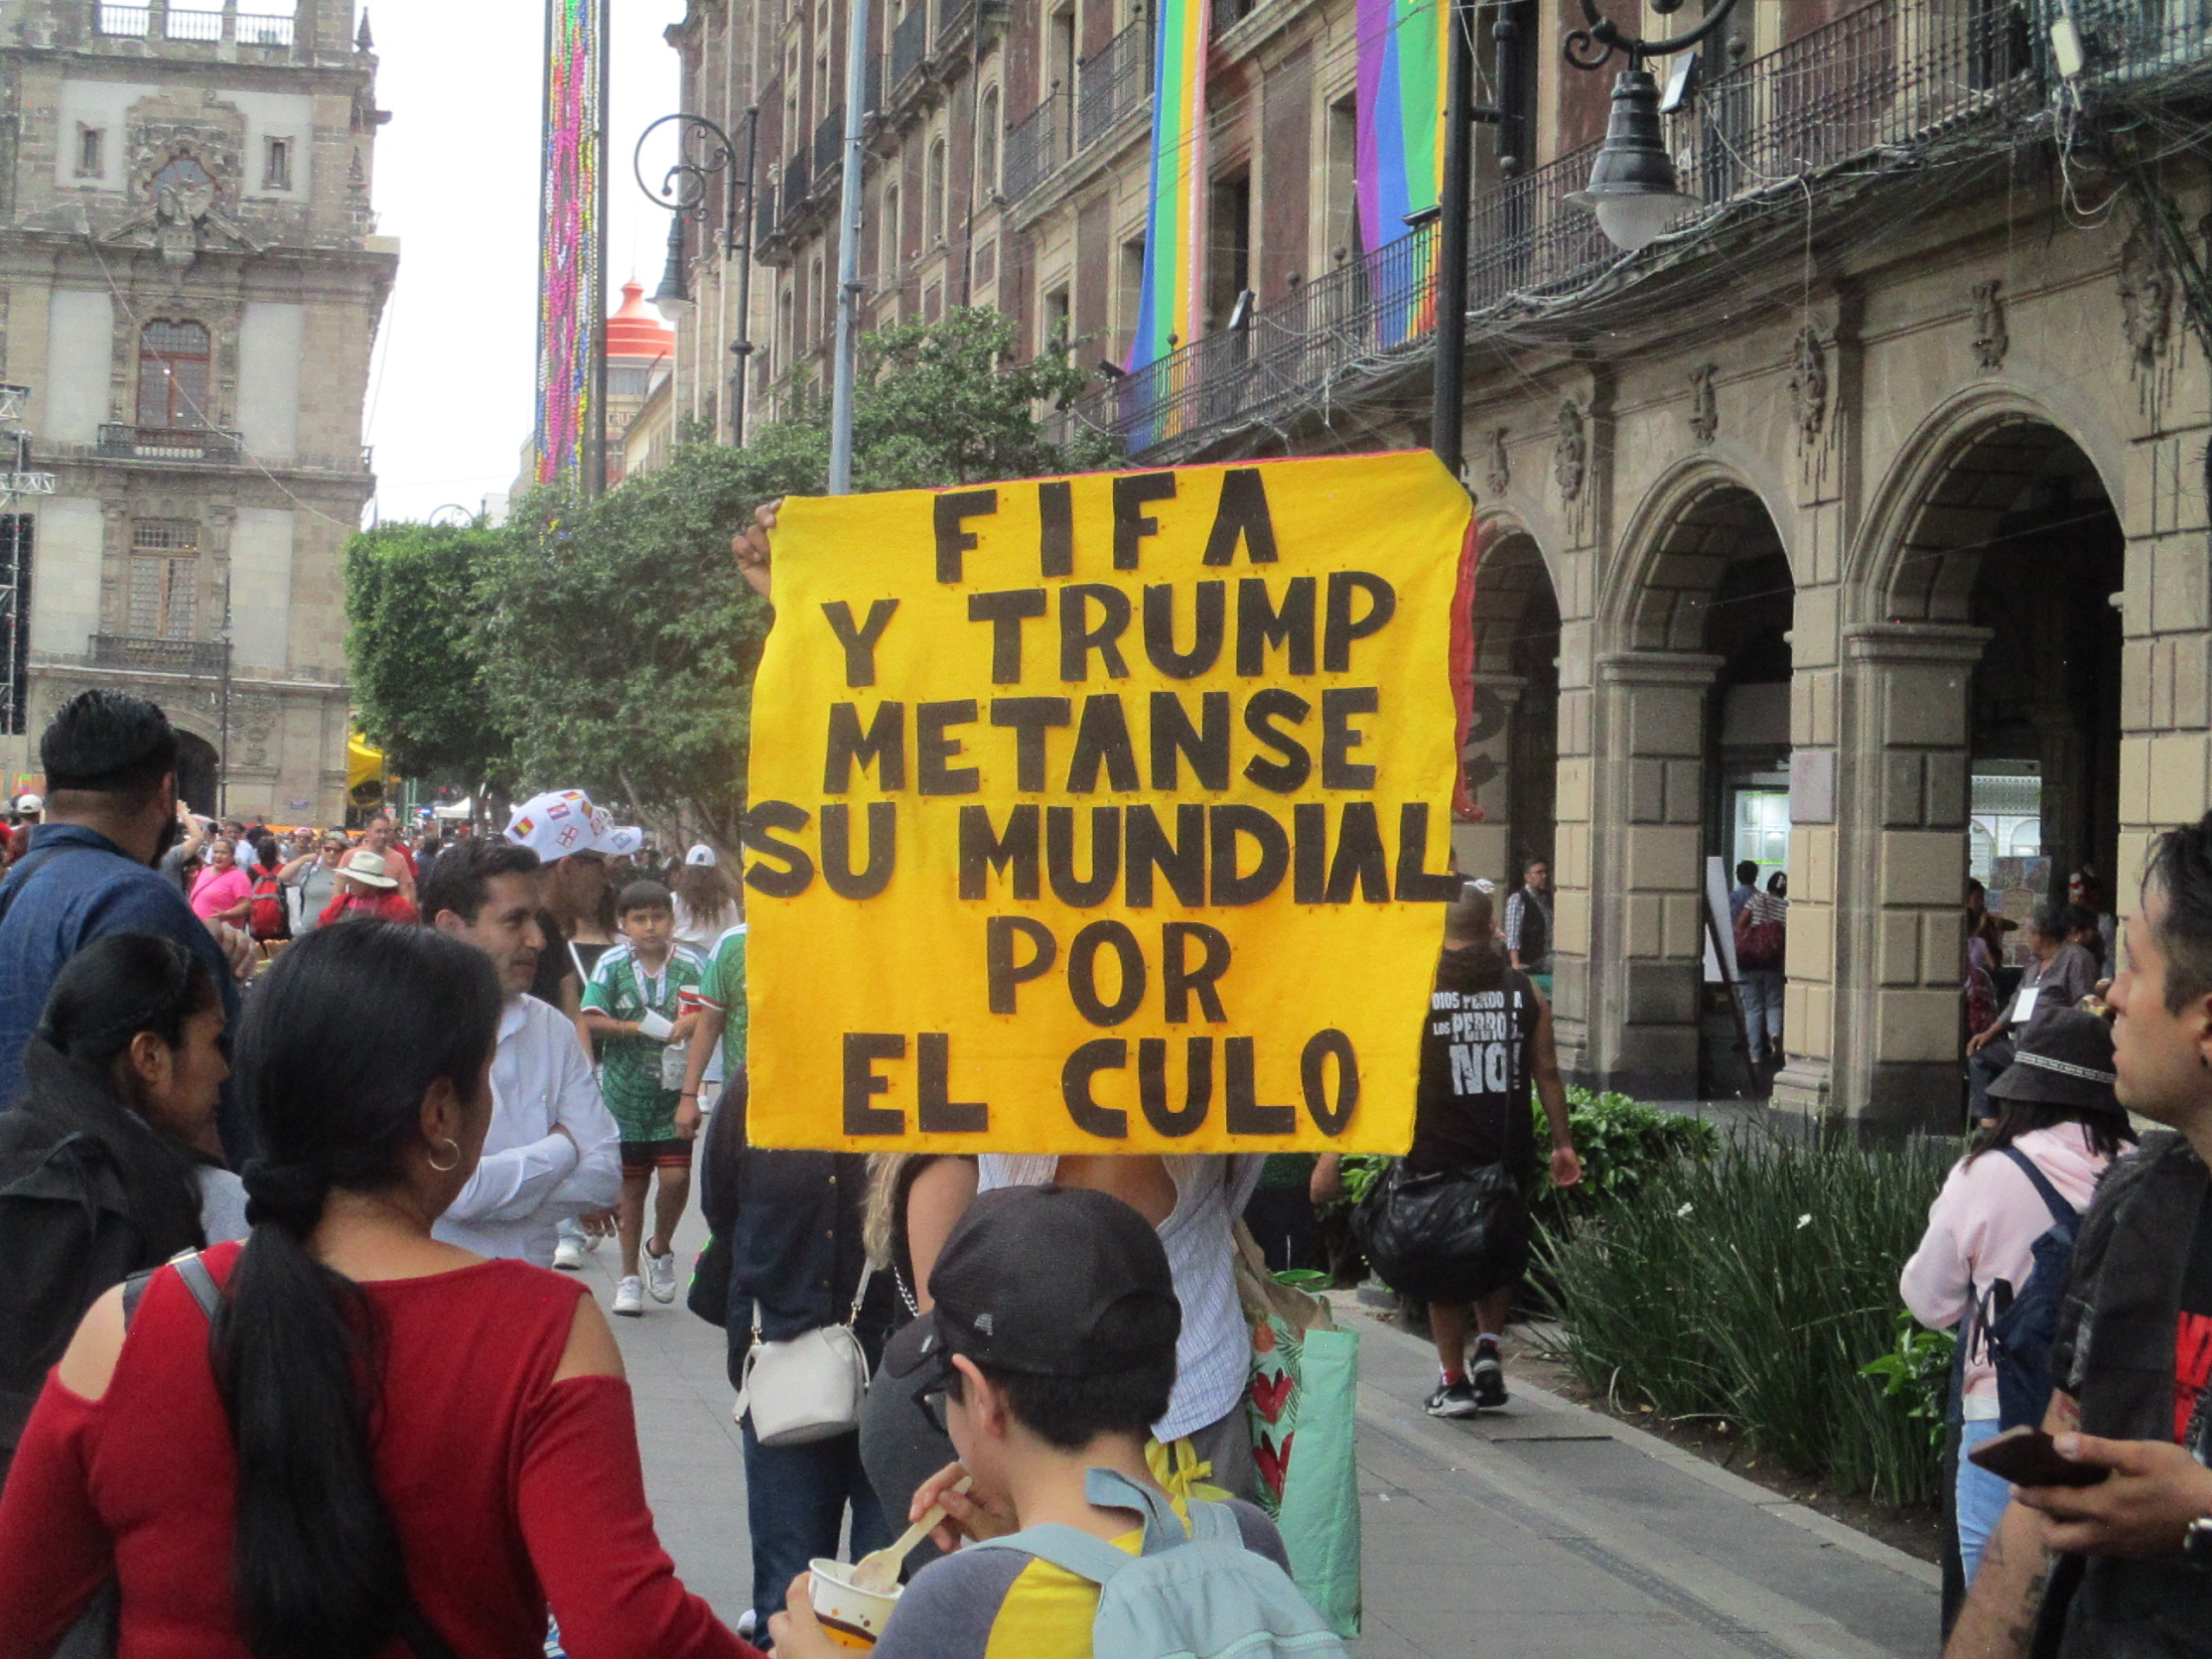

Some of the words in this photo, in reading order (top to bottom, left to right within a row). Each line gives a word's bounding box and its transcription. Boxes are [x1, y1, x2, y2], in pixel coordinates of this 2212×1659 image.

[933, 467, 1279, 584] FIFA
[822, 598, 899, 688] Y
[968, 570, 1396, 684] TRUMP
[823, 686, 1379, 796] METANSE
[742, 800, 897, 900] SU
[958, 801, 1462, 909] MUNDIAL
[987, 916, 1232, 1027] POR
[1432, 991, 1460, 1010] DIOS
[842, 1033, 988, 1136] EL
[1060, 1027, 1360, 1139] CULO
[1433, 1021, 1451, 1036] LOS
